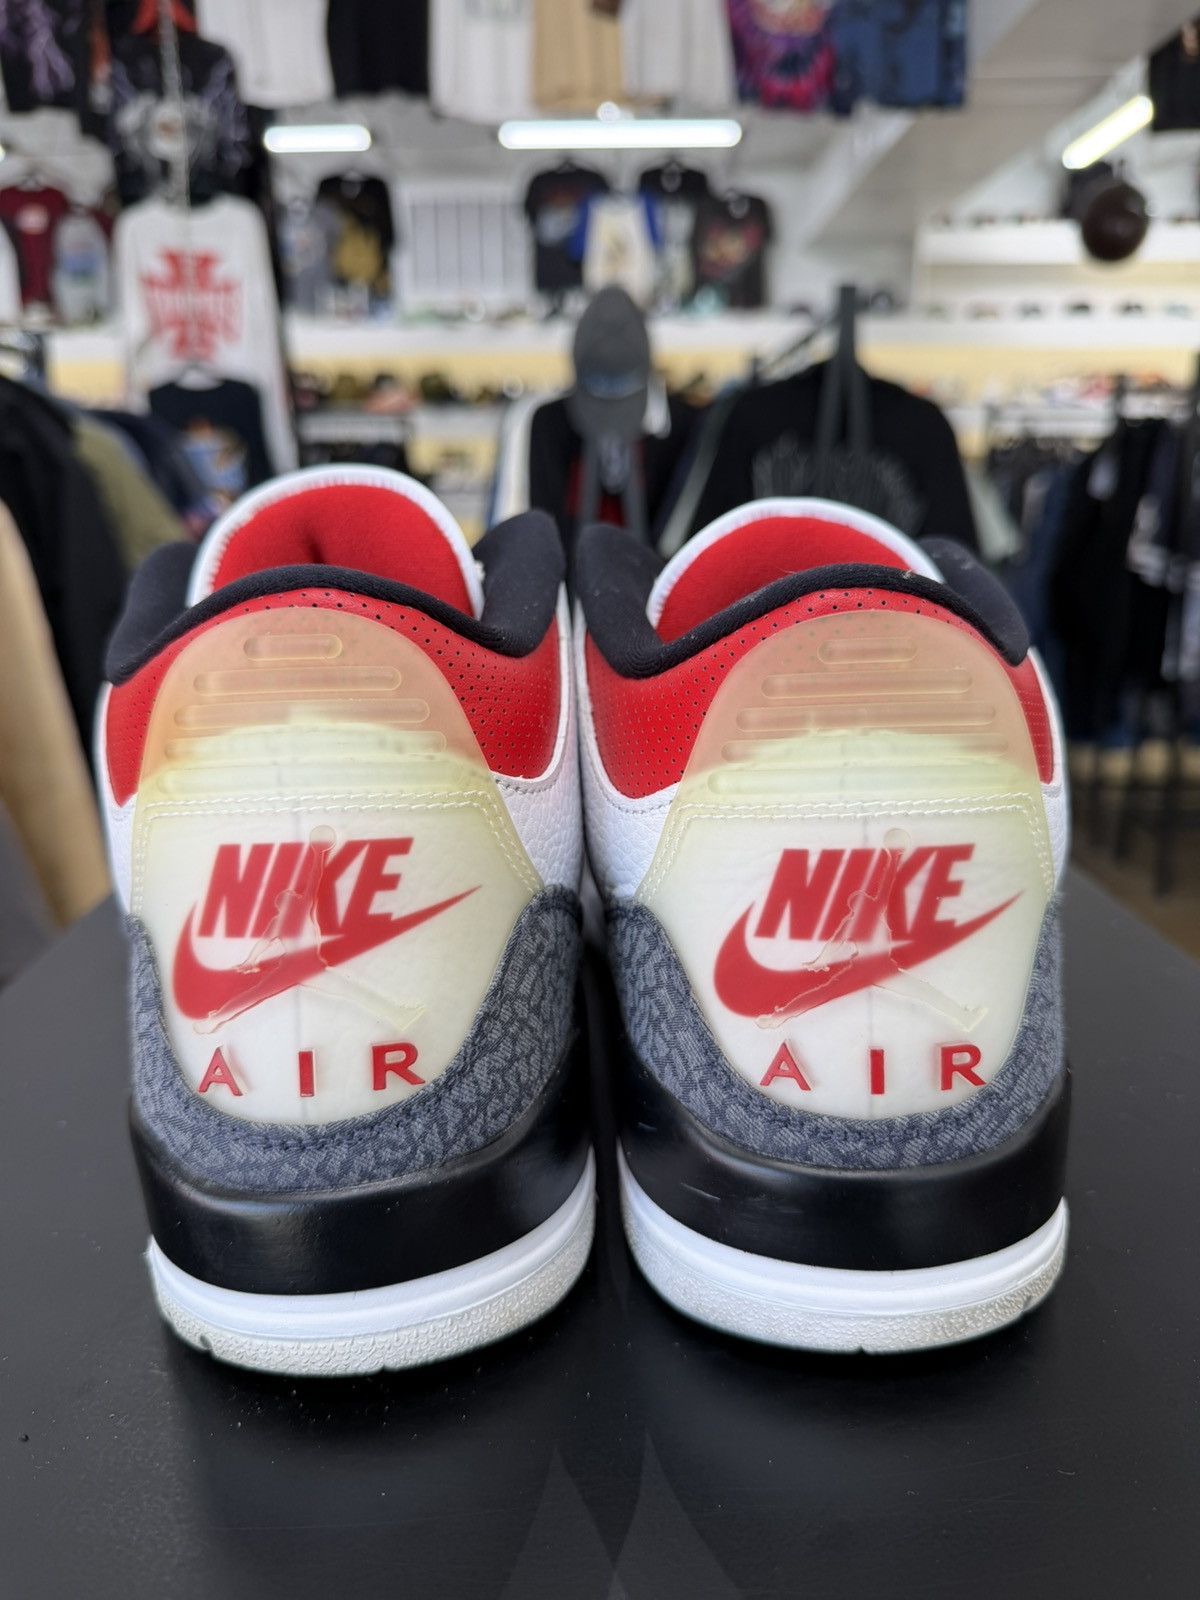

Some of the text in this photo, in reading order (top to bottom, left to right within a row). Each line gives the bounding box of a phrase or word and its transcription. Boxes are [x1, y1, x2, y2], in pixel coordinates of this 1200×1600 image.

[197, 837, 414, 938] NIKE
[754, 843, 975, 942] NIKE
[198, 1042, 425, 1097] AIR
[760, 1042, 986, 1095] AIR
